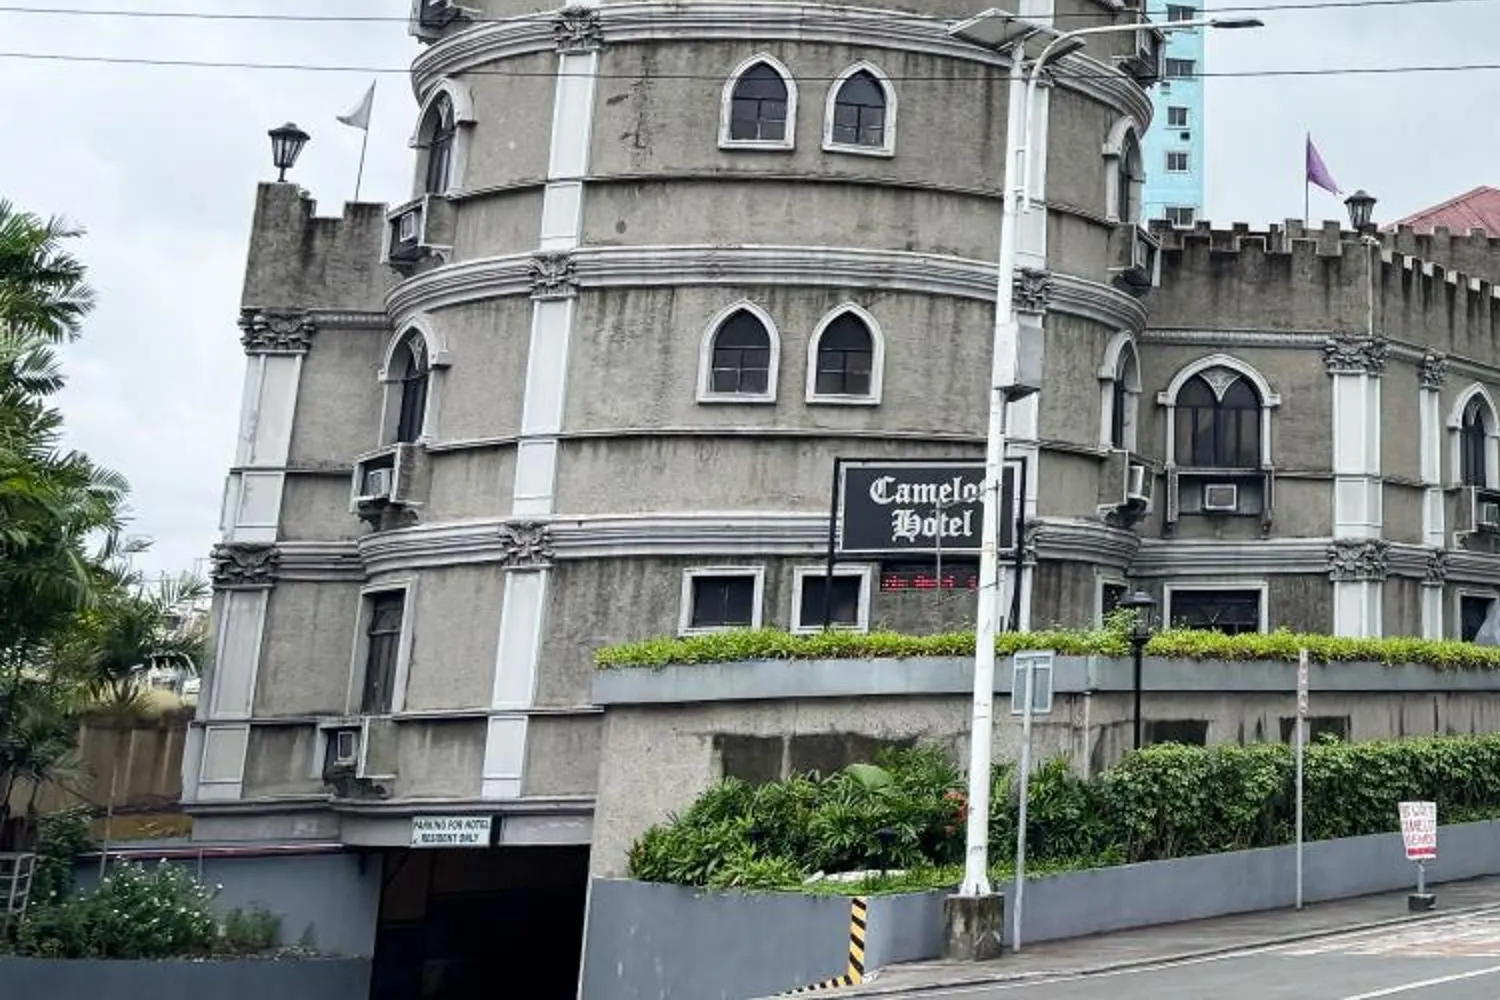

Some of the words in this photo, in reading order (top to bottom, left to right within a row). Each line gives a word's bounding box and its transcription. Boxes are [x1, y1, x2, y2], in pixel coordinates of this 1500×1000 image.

[890, 508, 974, 543] Hotel
[448, 820, 463, 830] FOR
[421, 833, 457, 843] RESIDENT
